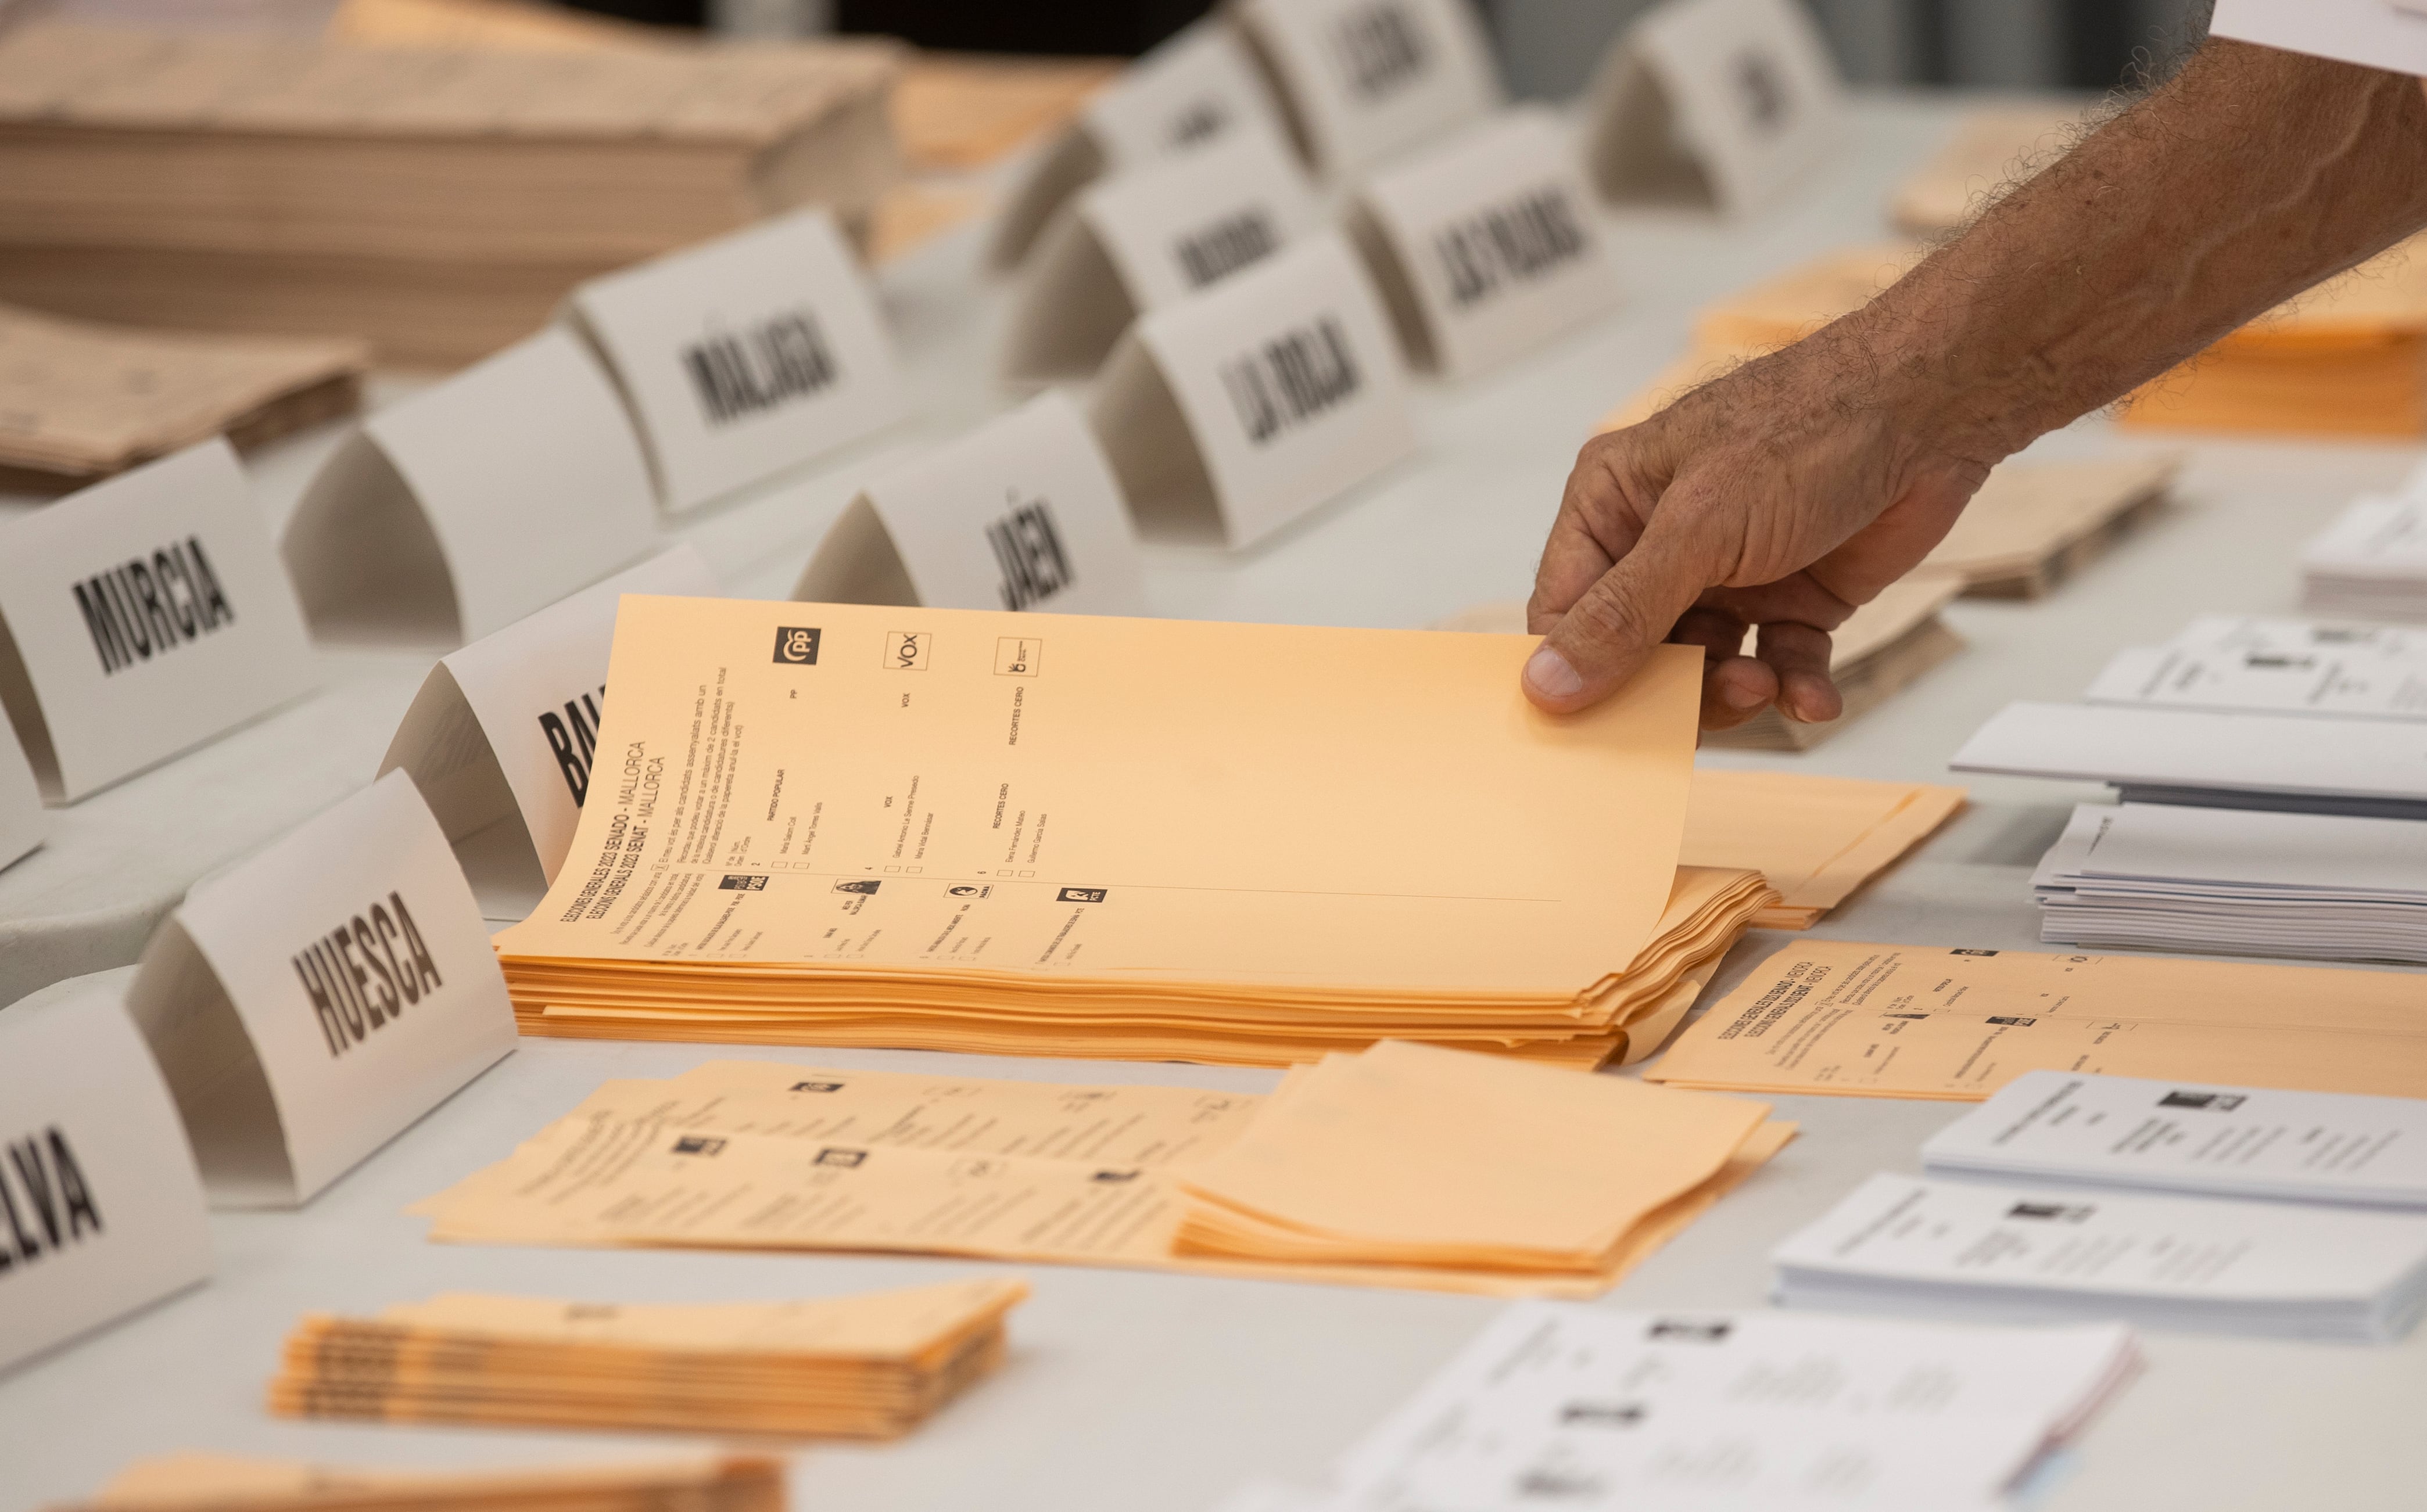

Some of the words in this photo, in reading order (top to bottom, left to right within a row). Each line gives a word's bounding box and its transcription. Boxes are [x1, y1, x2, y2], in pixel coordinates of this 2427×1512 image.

[73, 536, 234, 676] MURCIA
[897, 634, 917, 668] VOX
[715, 667, 727, 684] total
[698, 685, 707, 696] un
[715, 686, 723, 696] en
[790, 689, 798, 699] PP
[1012, 687, 1024, 707] CERO
[693, 698, 705, 718] amb
[901, 692, 910, 707] VOX
[708, 698, 722, 735] candidats
[721, 701, 735, 737] diferents)
[1008, 708, 1021, 745] RECORTES
[686, 720, 702, 767] assenyalats
[704, 743, 714, 753] de
[712, 738, 729, 783] candidatures
[618, 741, 645, 805] MALLORCA
[636, 756, 665, 817] MALLORCA
[677, 769, 693, 805] candidats
[700, 780, 707, 788] un
[710, 819, 725, 841] alteració
[721, 773, 735, 802] papereta
[733, 725, 743, 739] vot)
[710, 785, 719, 793] de
[908, 775, 920, 799] Presedo
[997, 783, 1009, 799] CERO
[694, 796, 704, 811] votar
[766, 798, 779, 821] PARTIDO
[773, 769, 785, 798] POPULAR
[883, 796, 893, 808] VOX
[674, 806, 684, 816] als
[812, 802, 823, 814] Valls
[903, 800, 915, 817] Senne
[992, 800, 1006, 829] RECORTES
[672, 817, 683, 828] per
[687, 812, 701, 829] podeu
[698, 800, 716, 834] candidatura
[787, 816, 797, 826] Coll
[808, 815, 820, 829] Torres
[920, 813, 934, 835] Bennásar
[1013, 810, 1026, 827] Mateo
[1035, 814, 1047, 828] Salas
[604, 814, 630, 851] SENADO
[627, 825, 648, 852] SENAT
[666, 837, 676, 845] vot
[686, 831, 695, 841] que
[783, 827, 794, 841] Salom
[897, 825, 909, 843] Antonio
[1008, 827, 1021, 850] Fernández
[1031, 828, 1044, 843] García
[694, 835, 708, 853] mateixa
[917, 836, 928, 847] Vidal
[663, 846, 673, 857] meu
[892, 843, 904, 858] Gabriel
[1005, 852, 1016, 863] Elena
[1027, 843, 1041, 863] Guillermo
[597, 852, 616, 867] 2023
[620, 854, 639, 868] 2023
[580, 868, 611, 897] GENERALES
[604, 870, 633, 896] GENERALS
[745, 876, 766, 890] PSOE
[978, 886, 990, 898] PACMA
[1089, 892, 1100, 901] PCTE
[560, 897, 593, 922] ELECCIONES
[586, 896, 618, 919] ELECCIONS
[291, 889, 443, 1058] HUESCA
[1790, 985, 1814, 997] SENAT
[1803, 966, 1833, 983] MENORCA
[1741, 1001, 1772, 1020] GENERALES
[1766, 981, 1795, 995] SENADO
[1785, 961, 1814, 978] MENORCA
